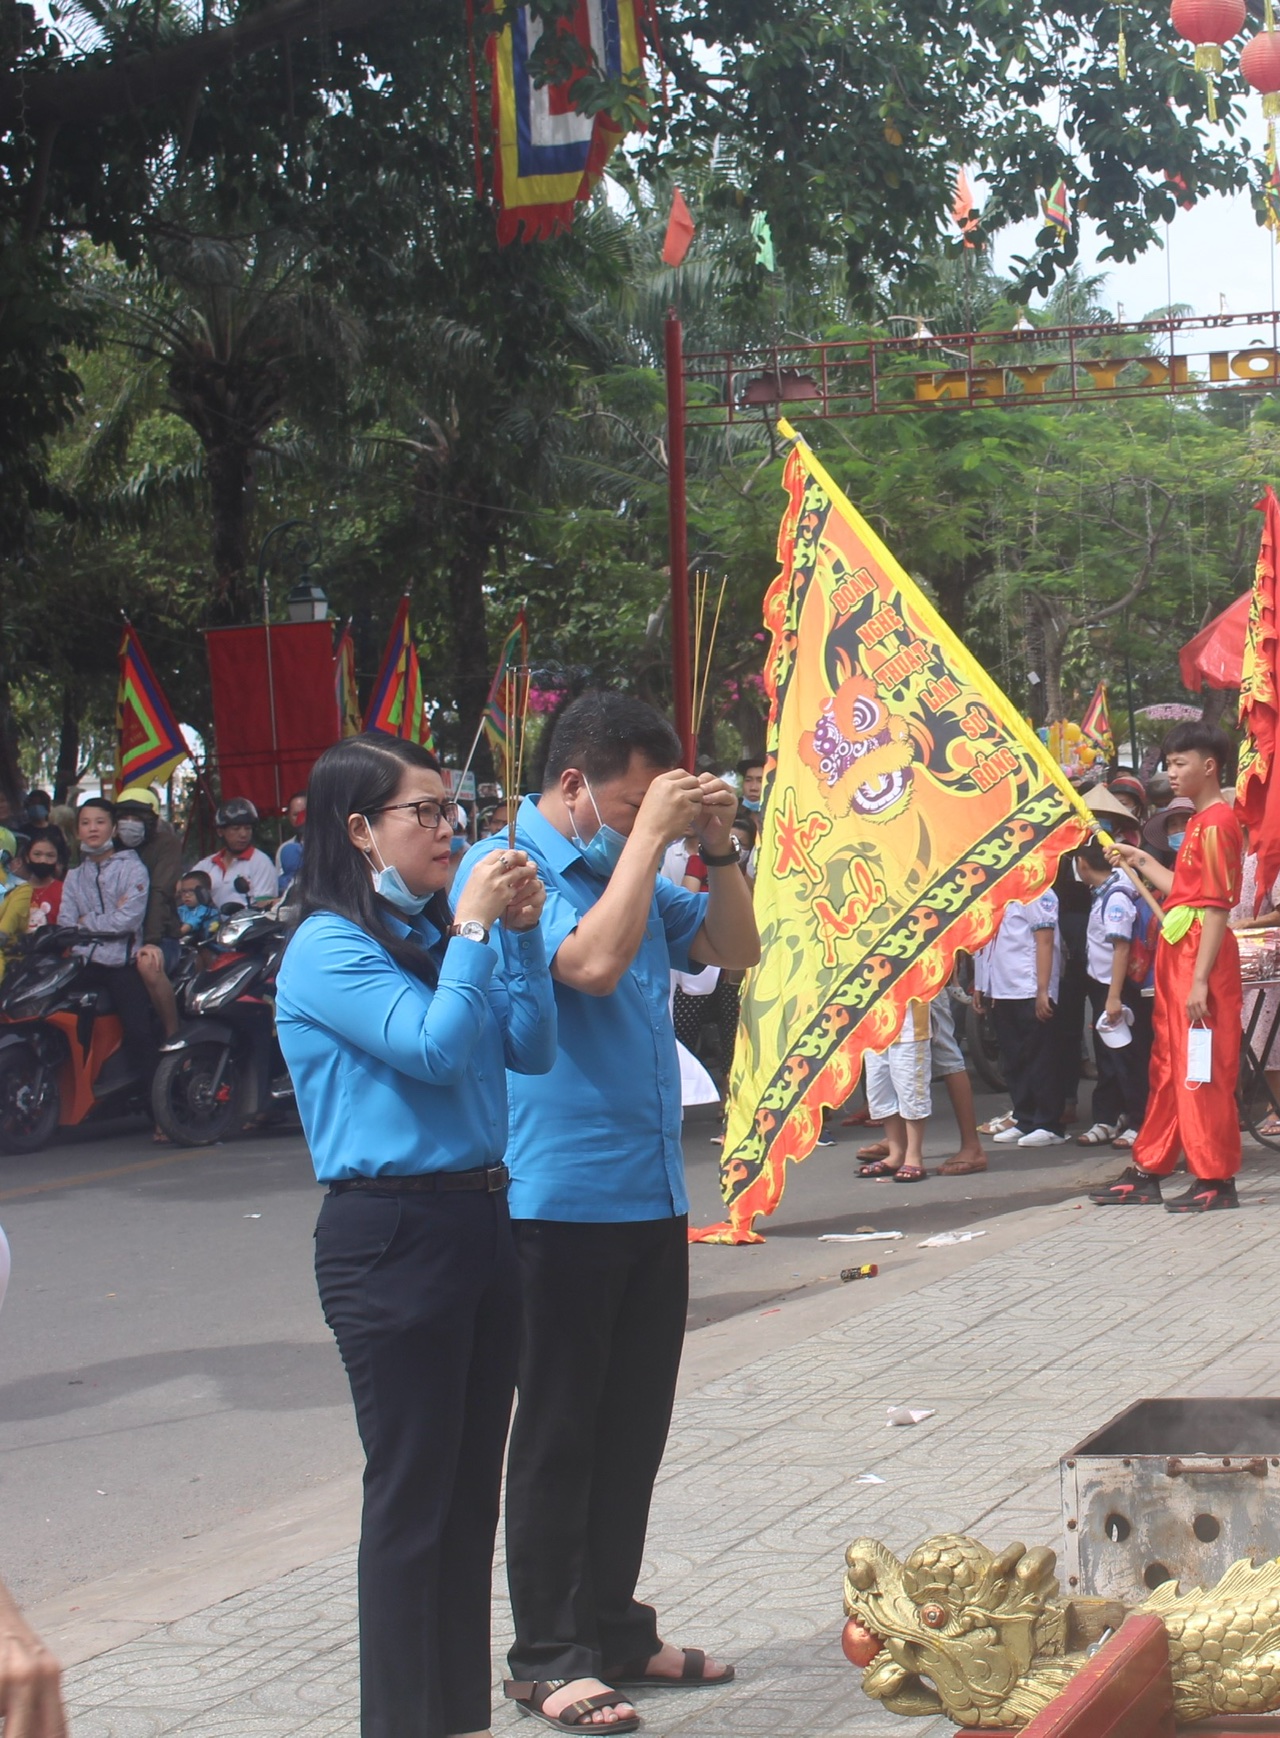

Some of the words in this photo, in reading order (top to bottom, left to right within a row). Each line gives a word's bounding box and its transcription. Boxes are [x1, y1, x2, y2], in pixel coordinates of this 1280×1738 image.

[831, 568, 877, 614] ĐOÀN
[856, 602, 904, 648] NGHỆ
[874, 640, 930, 690] THUẬT
[919, 676, 961, 712] LÂN
[960, 706, 989, 741] SƯ
